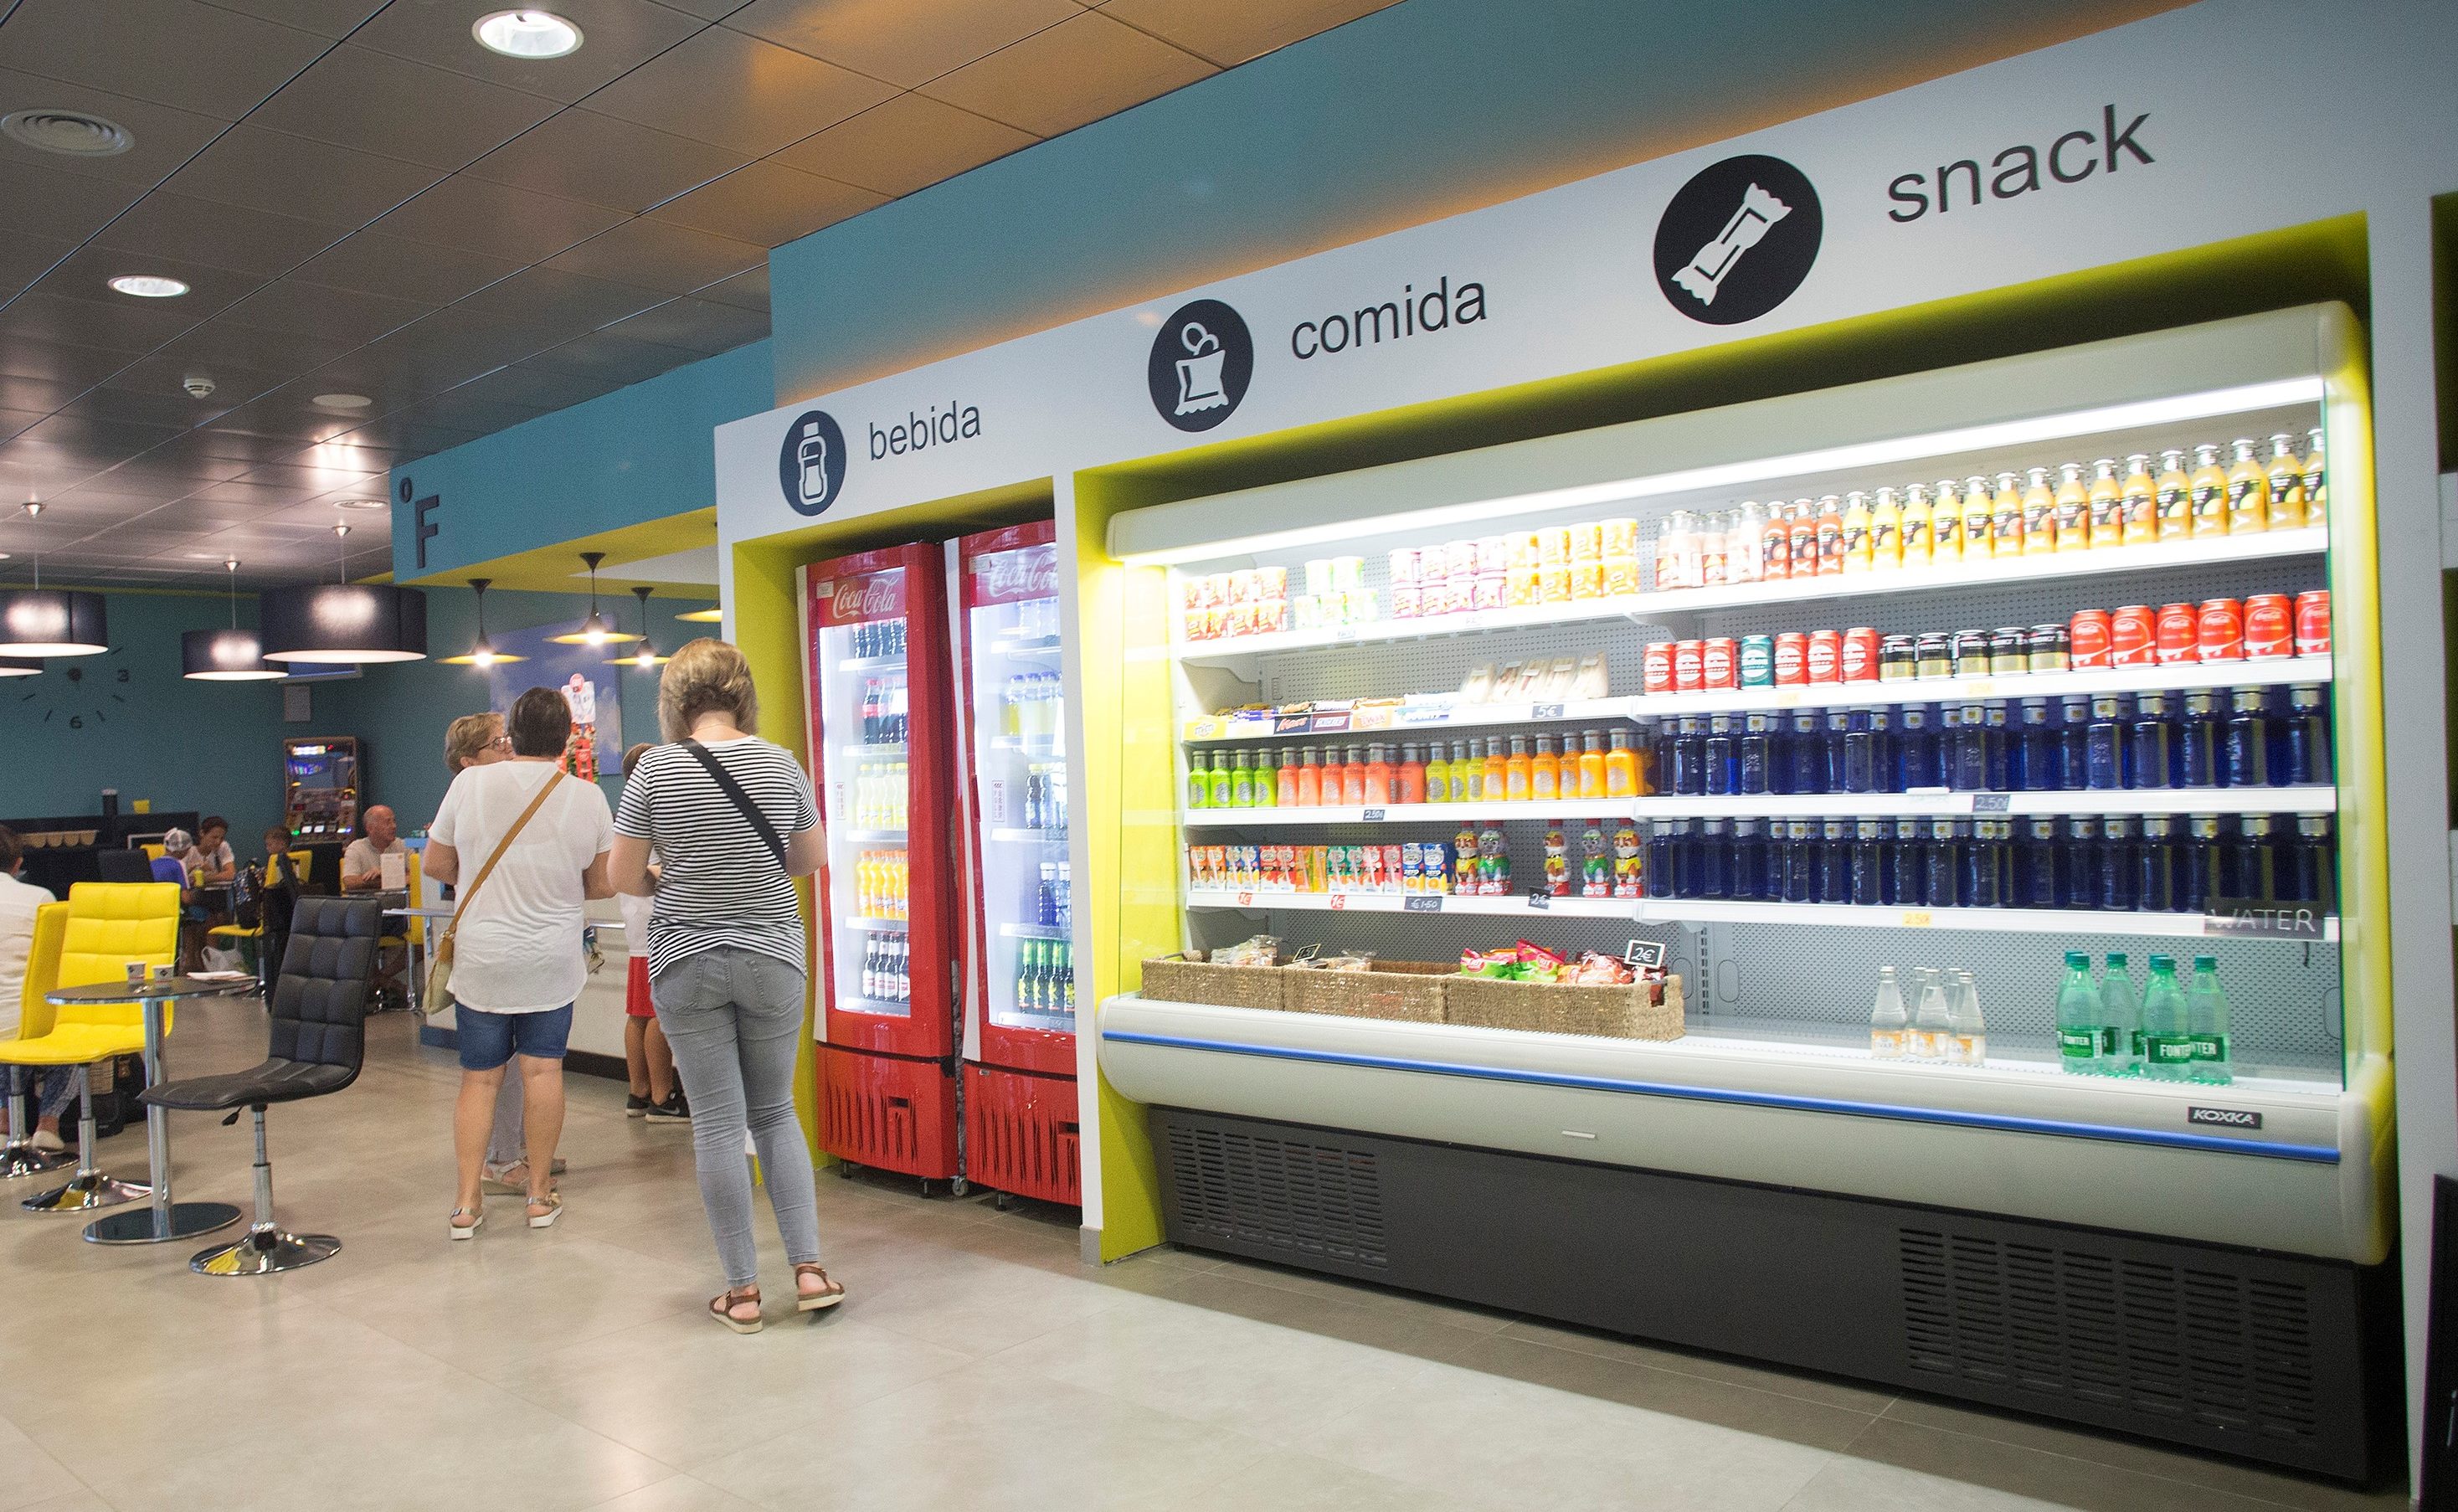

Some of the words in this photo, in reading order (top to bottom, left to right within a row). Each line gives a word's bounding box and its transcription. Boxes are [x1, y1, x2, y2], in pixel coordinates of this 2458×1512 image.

[1888, 103, 2156, 224] snack
[1291, 275, 1488, 360] comida
[869, 399, 981, 461] bebida
[69, 716, 83, 729] 6
[2210, 908, 2316, 933] WATER
[1630, 946, 1657, 963] 2€
[2193, 1108, 2256, 1125] KOXKA
